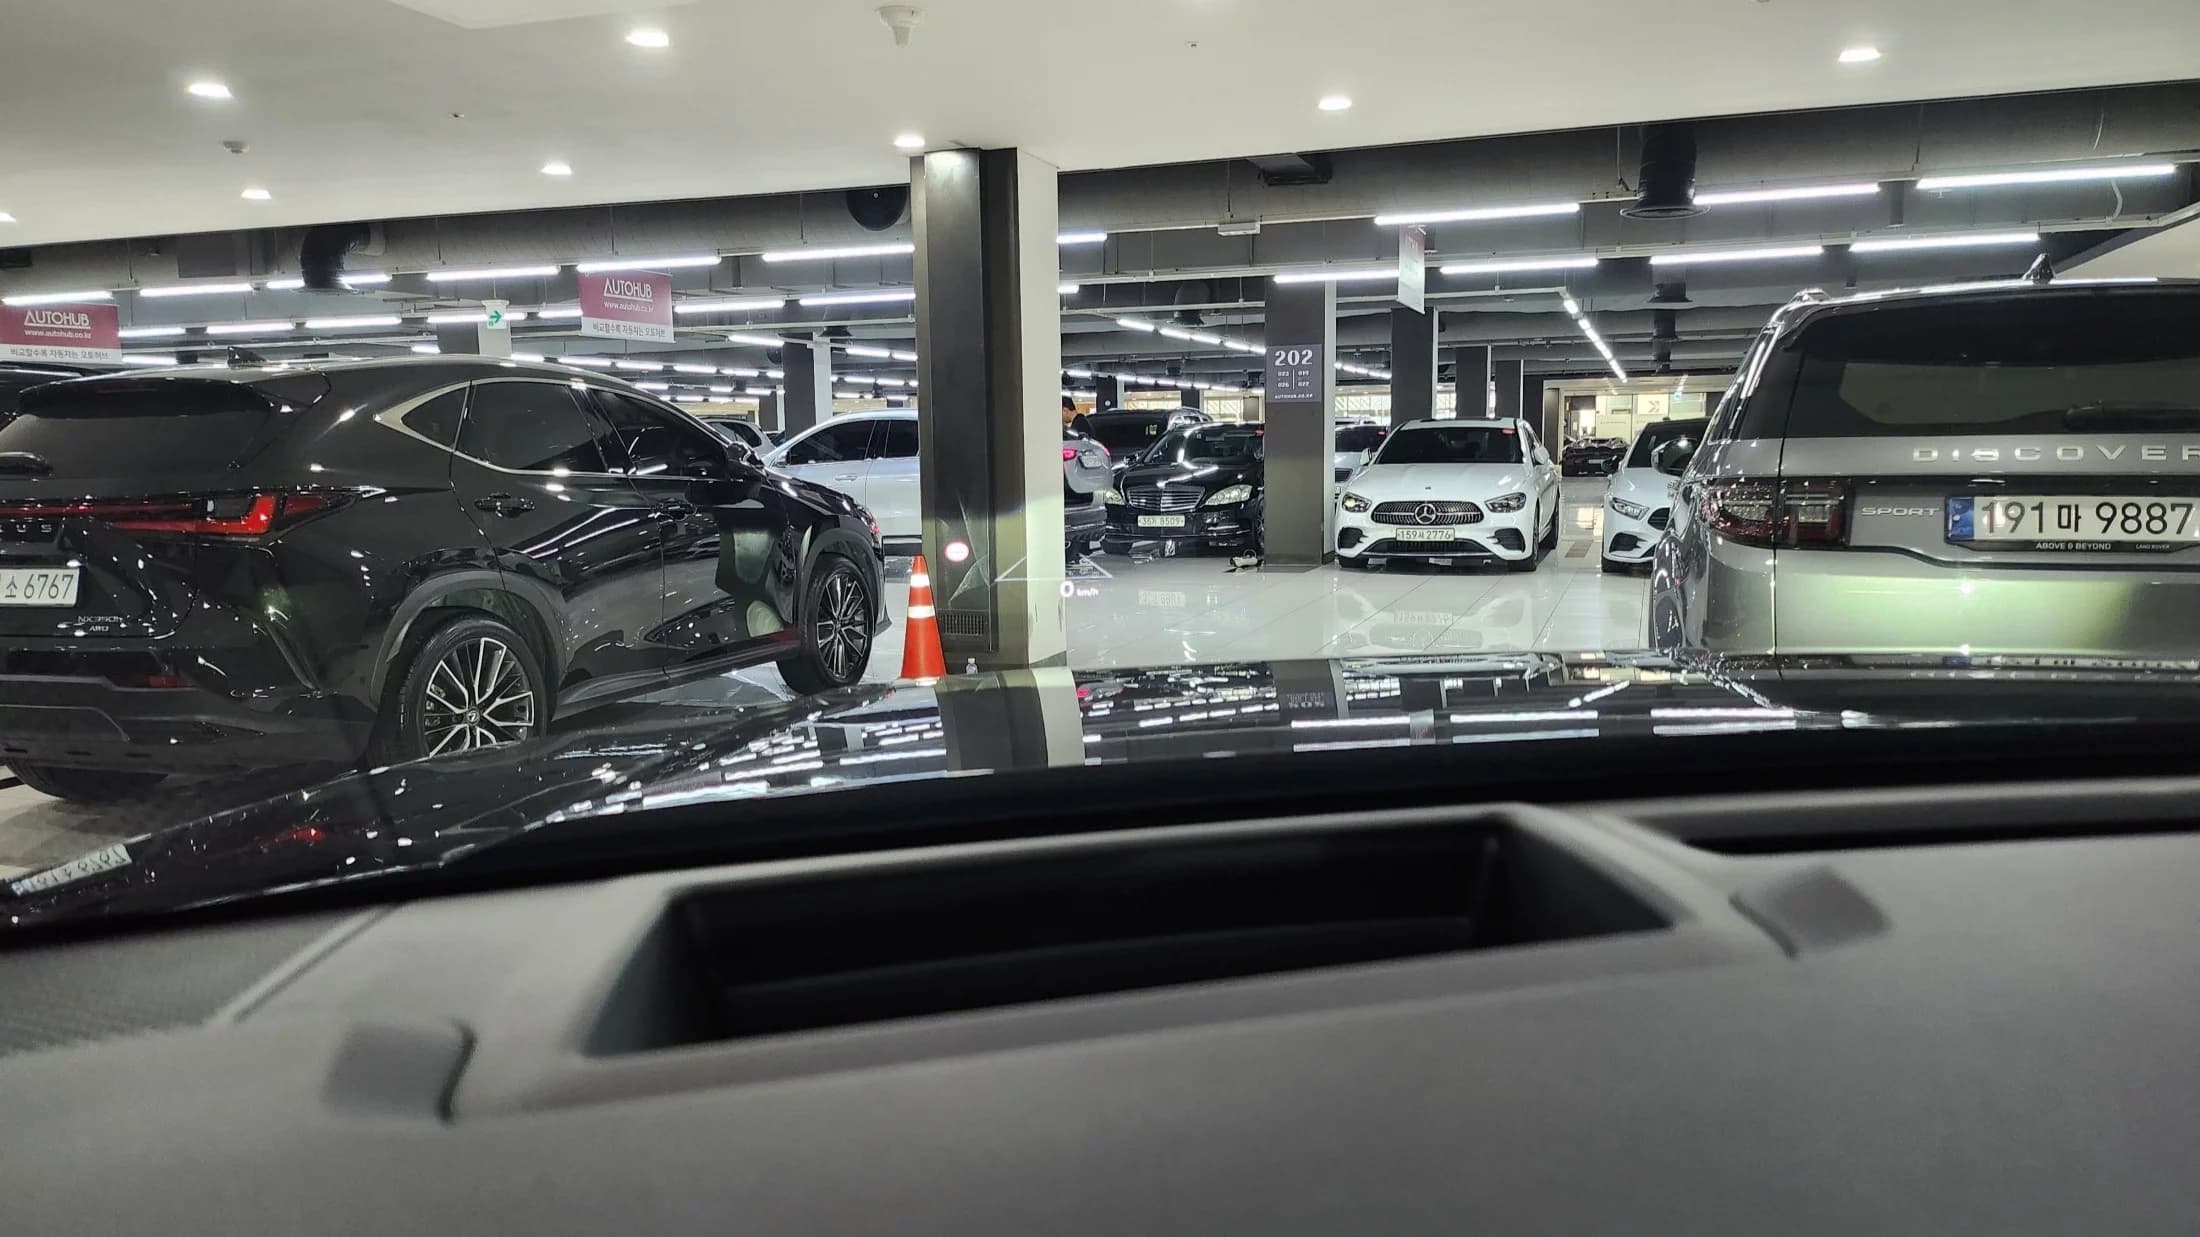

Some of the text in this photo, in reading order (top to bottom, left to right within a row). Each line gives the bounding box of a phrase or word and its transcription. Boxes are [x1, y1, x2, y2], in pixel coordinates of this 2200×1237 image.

[603, 278, 653, 301] AUTOHUB
[24, 310, 91, 329] AUTOHUB
[24, 329, 91, 339] www.autohub.co.kr
[1274, 349, 1313, 366] 202
[1860, 506, 1940, 517] SPORT
[2095, 501, 2195, 535] 9887
[2035, 542, 2065, 550] ABOVE
[2076, 542, 2112, 550] BEYOND
[23, 574, 75, 599] 6767
[1060, 580, 1100, 598] 0 km/h
